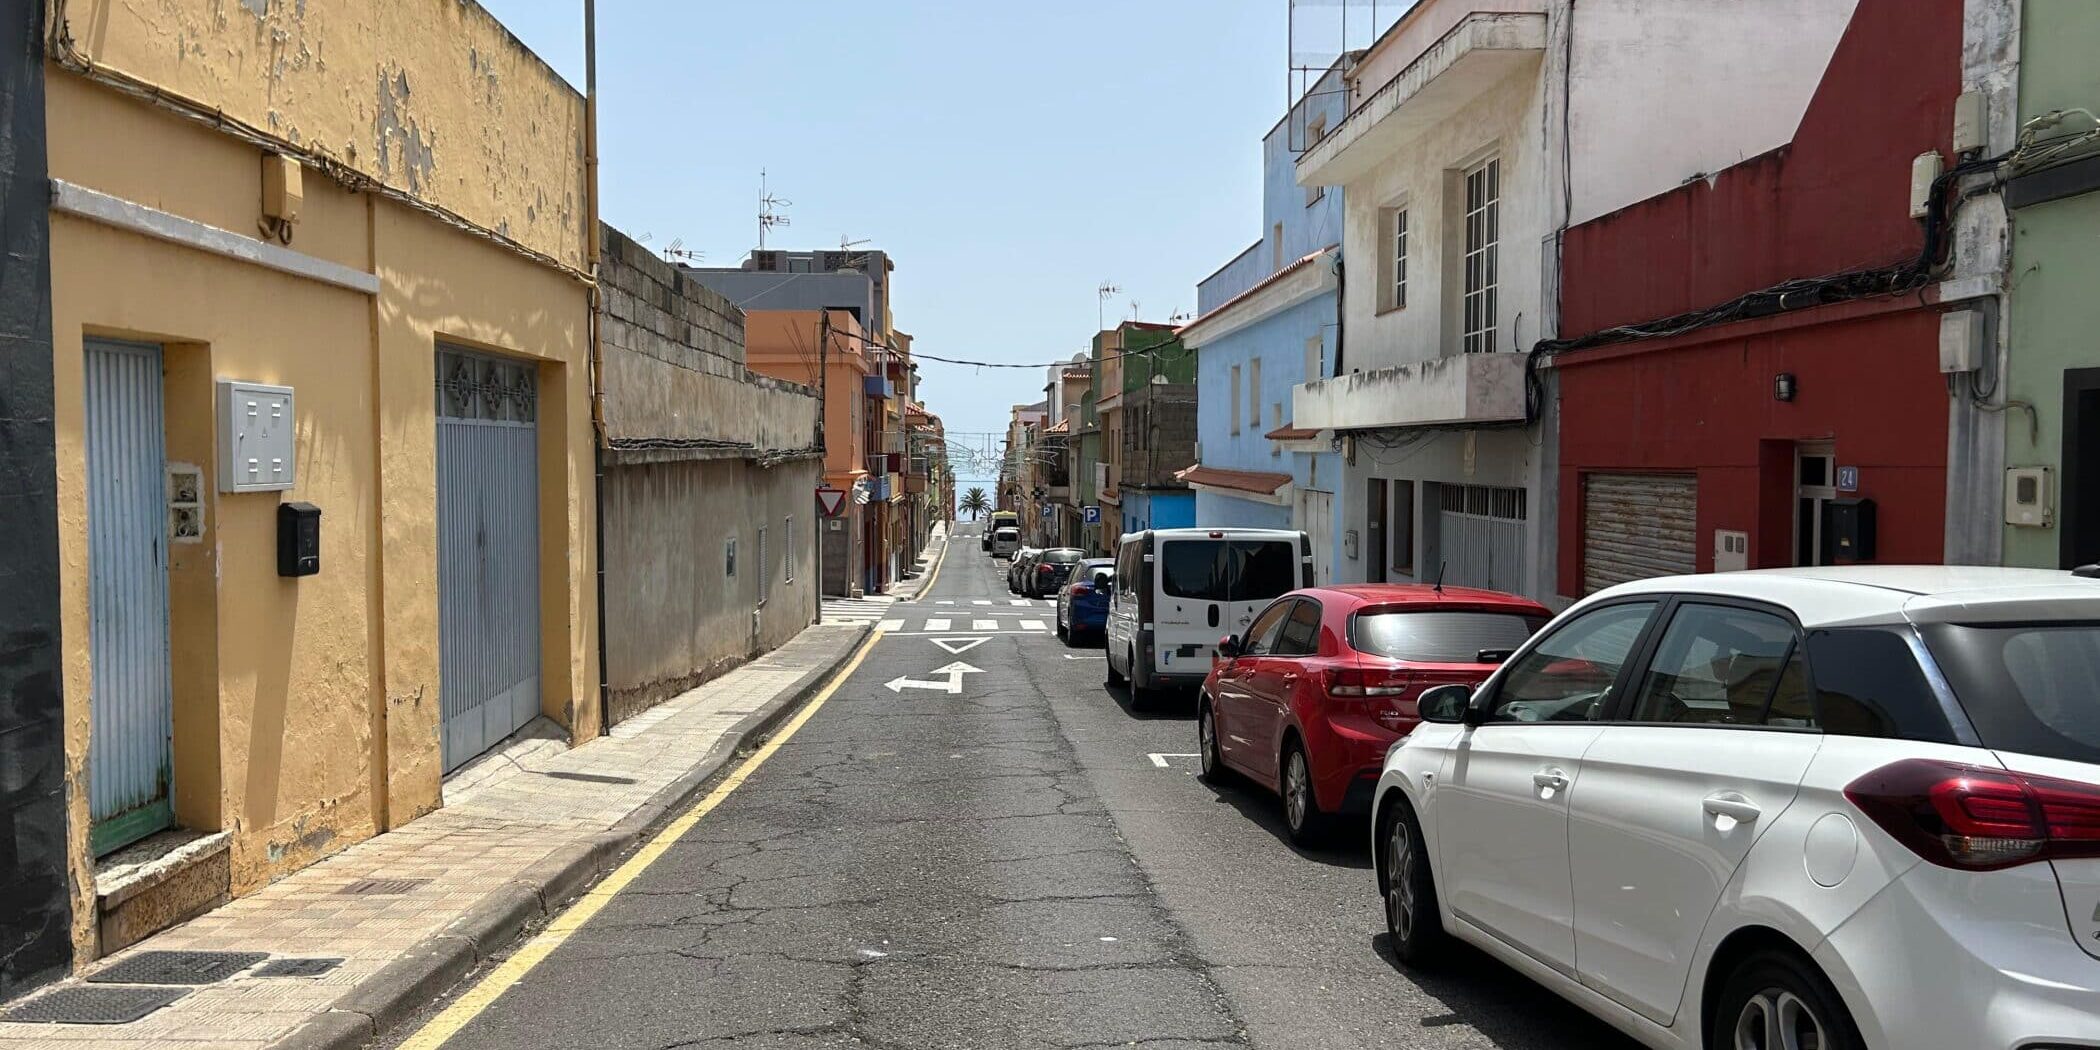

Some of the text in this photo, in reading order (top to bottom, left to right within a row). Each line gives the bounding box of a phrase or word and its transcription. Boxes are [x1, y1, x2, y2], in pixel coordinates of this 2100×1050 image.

[1841, 470, 1854, 486] 24
[1043, 507, 1050, 516] P
[1086, 508, 1097, 521] P
